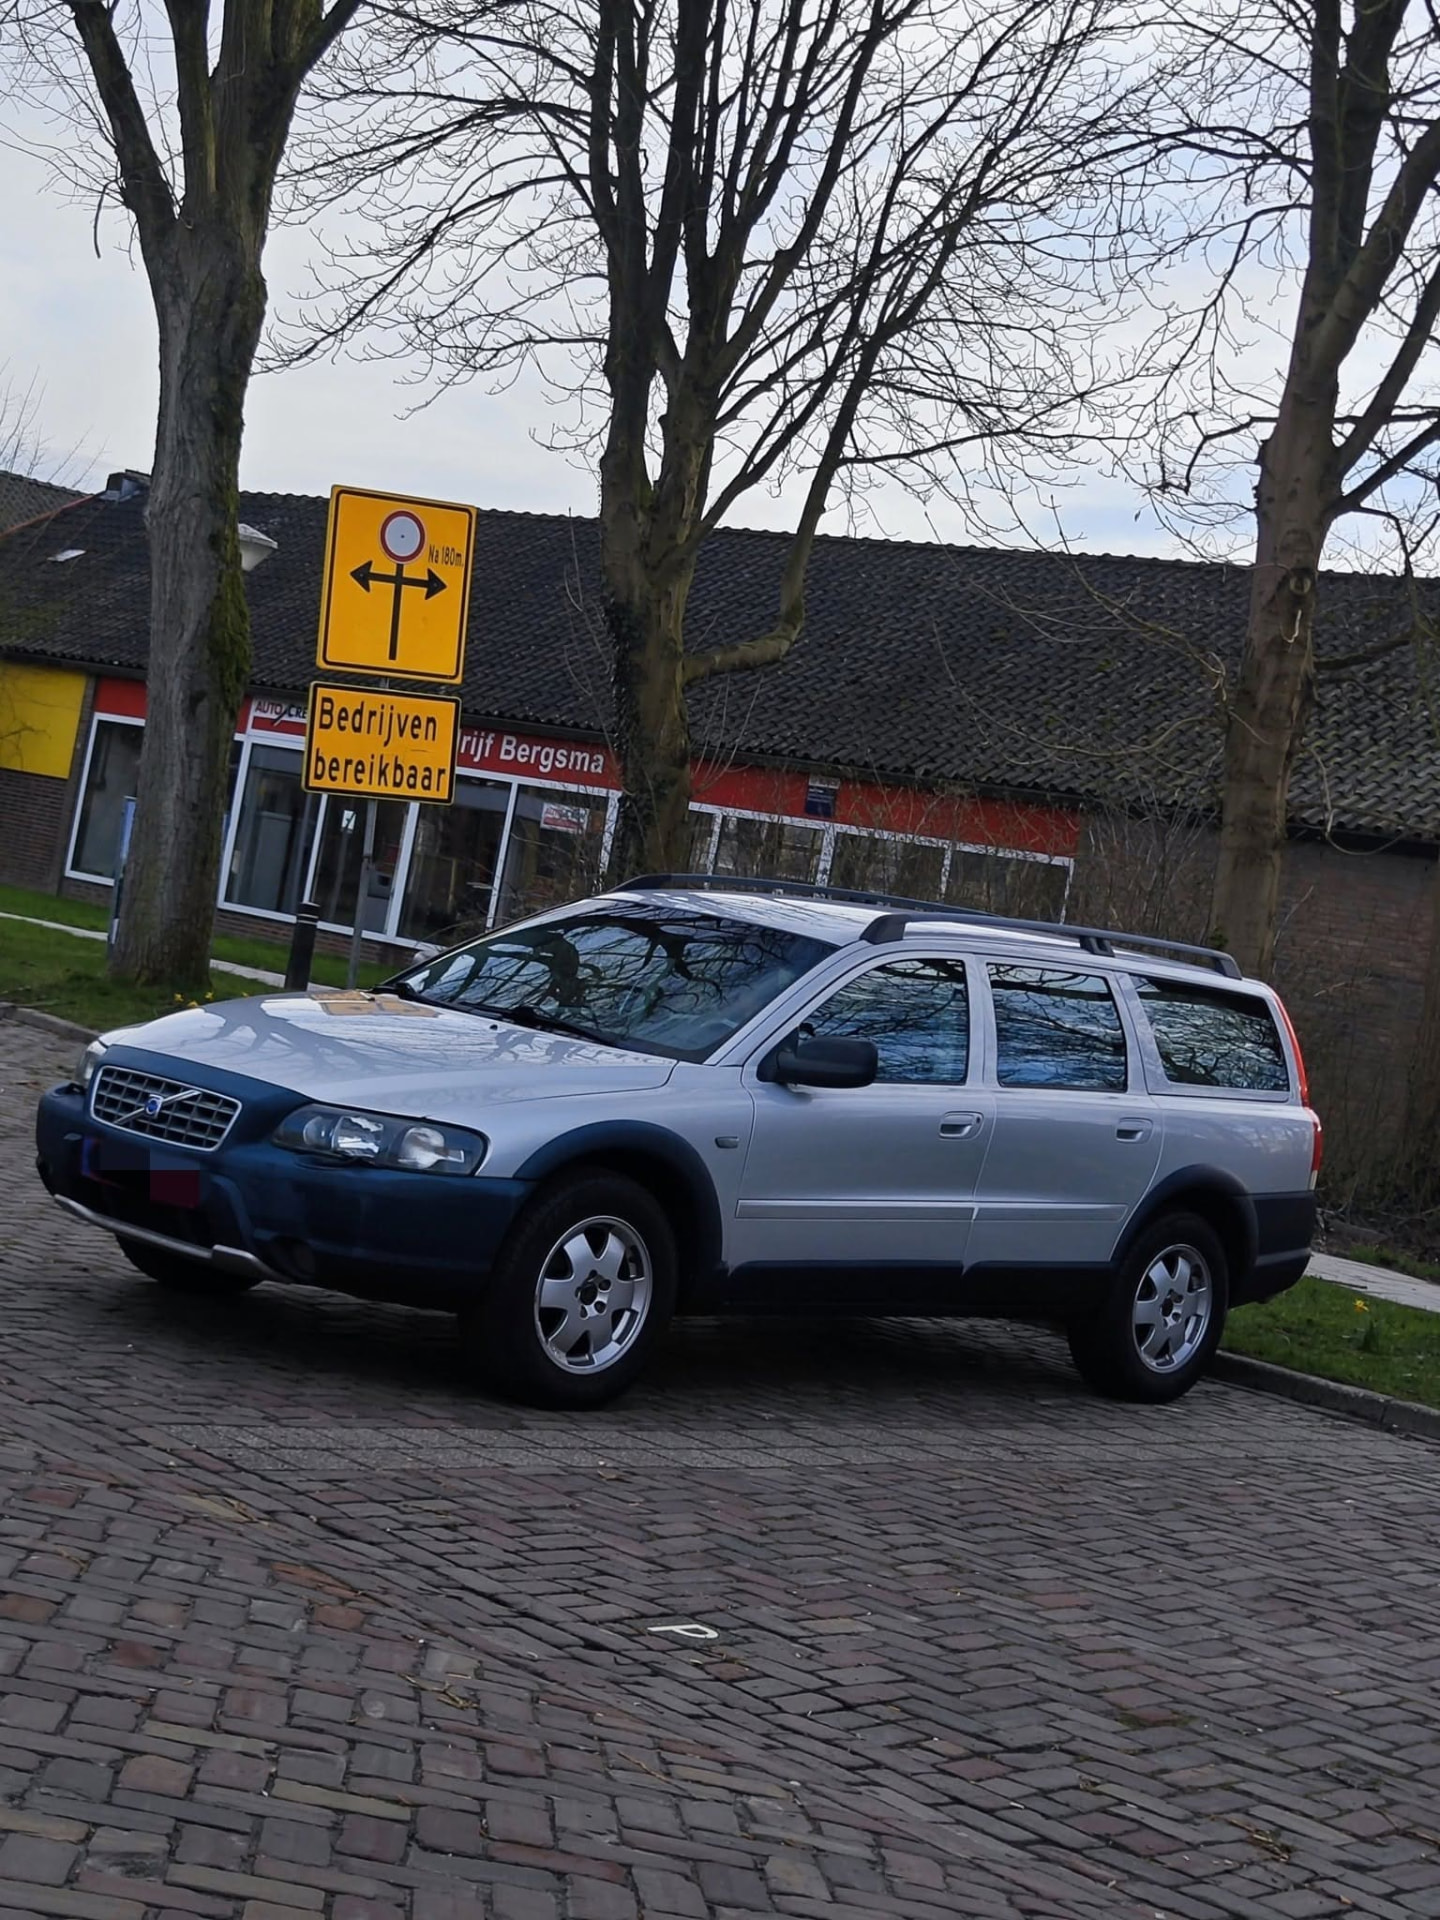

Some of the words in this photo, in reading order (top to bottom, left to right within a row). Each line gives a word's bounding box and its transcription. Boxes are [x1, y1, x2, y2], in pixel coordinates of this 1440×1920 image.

[428, 544, 439, 564] Na
[319, 697, 437, 747] Bedrijven
[313, 748, 446, 792] bereikbaar
[459, 731, 496, 762] rijf
[499, 735, 605, 773] Bergsma
